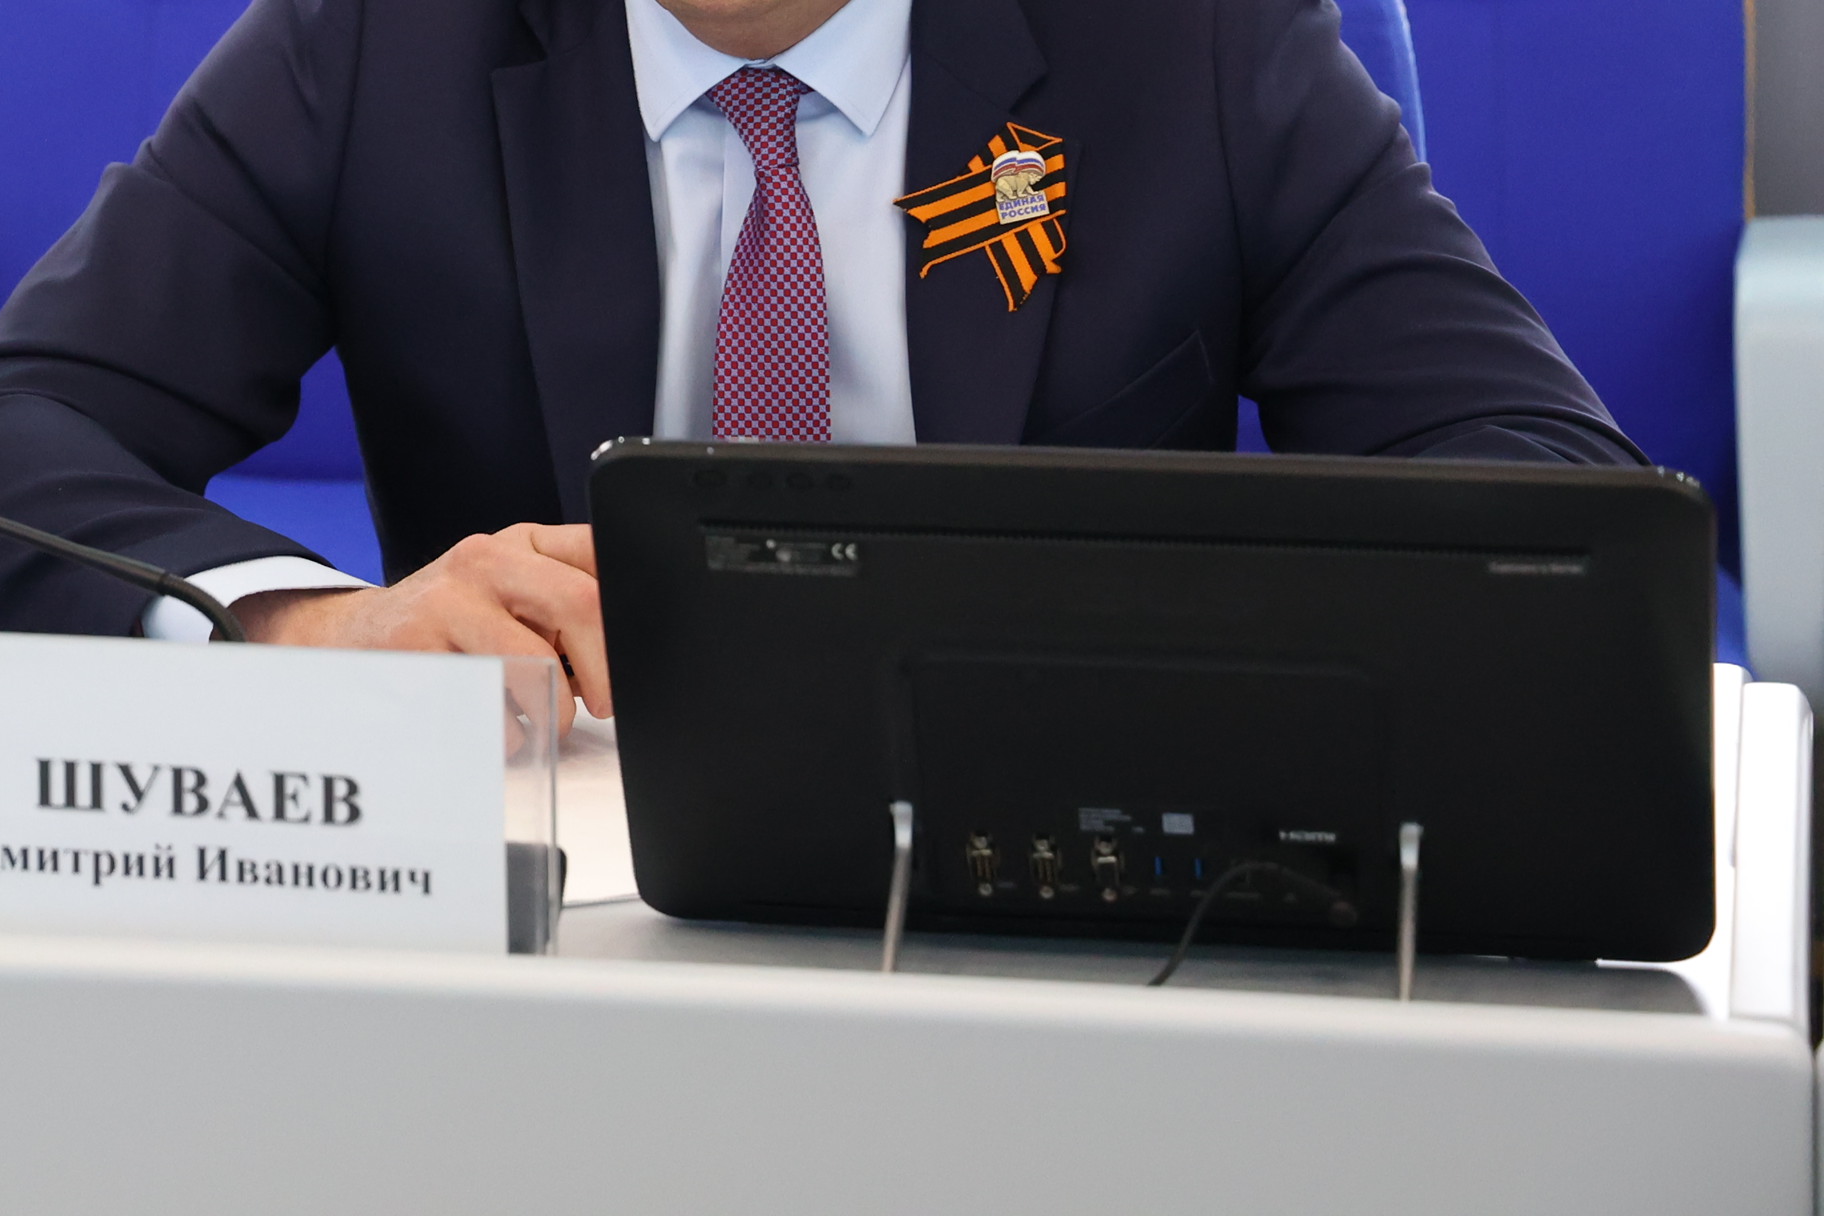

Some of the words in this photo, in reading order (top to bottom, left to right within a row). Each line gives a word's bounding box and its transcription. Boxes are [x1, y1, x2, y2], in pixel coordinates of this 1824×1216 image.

[999, 195, 1044, 210] ЕДИНАЯ
[1001, 204, 1046, 219] РОССИЯ
[36, 758, 363, 827] ШУВАЕВ
[196, 845, 433, 897] Иванович
